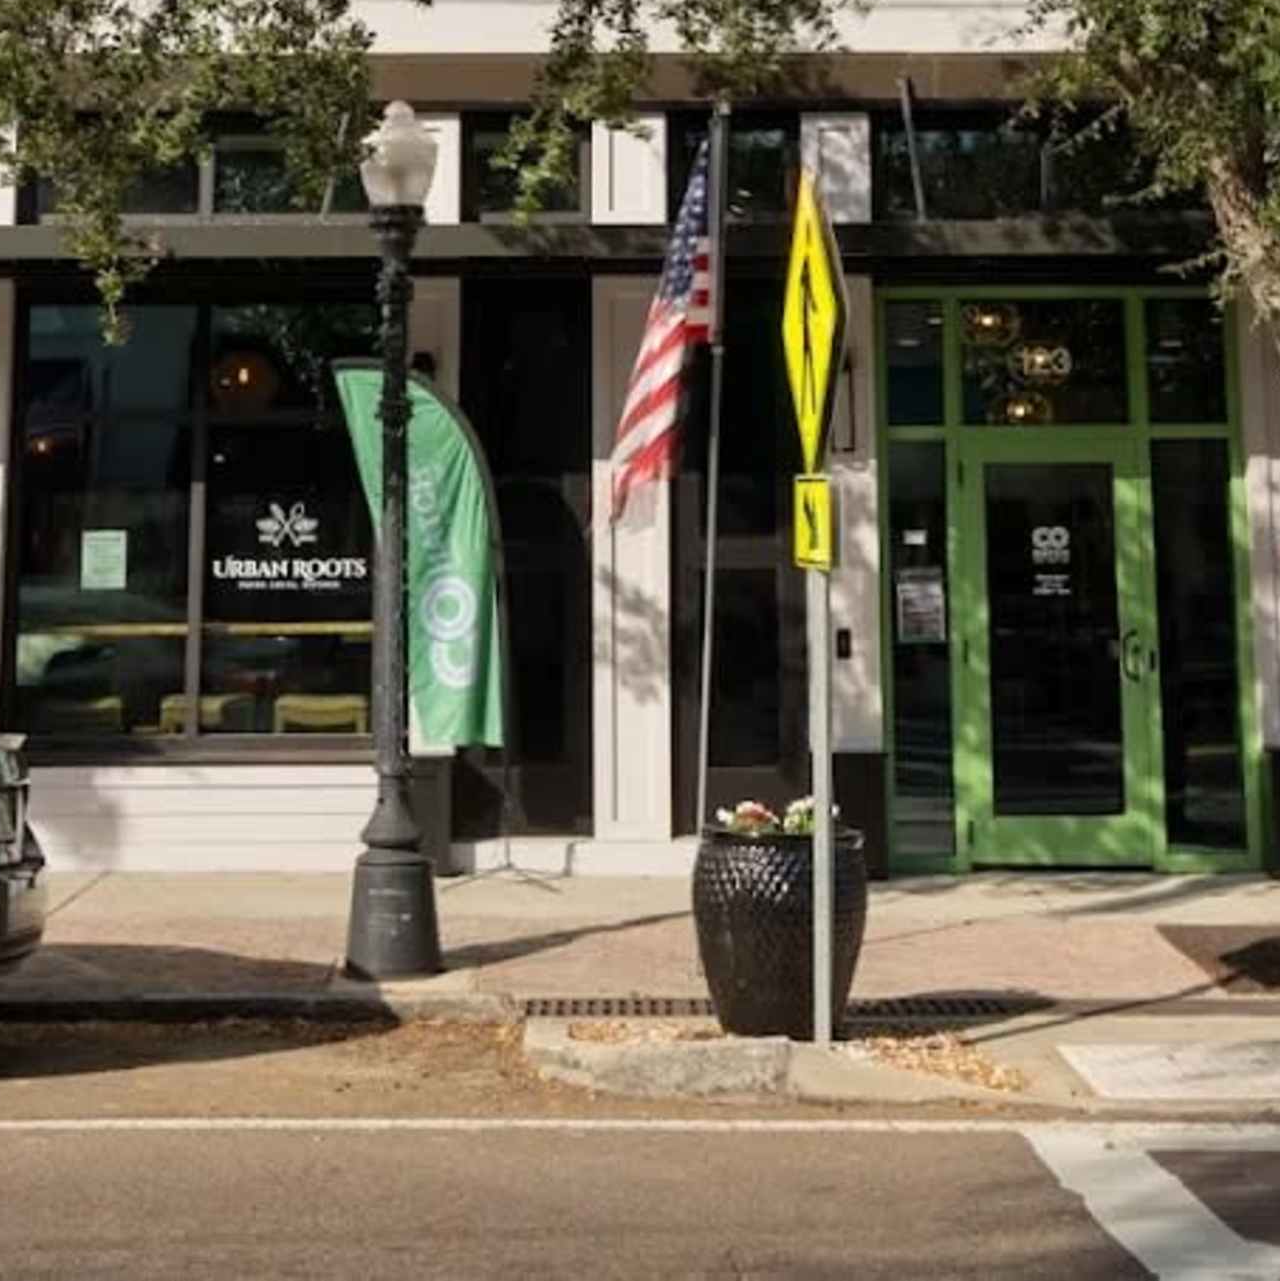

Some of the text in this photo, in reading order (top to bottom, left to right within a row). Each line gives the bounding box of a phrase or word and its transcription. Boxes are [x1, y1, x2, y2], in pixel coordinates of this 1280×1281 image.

[1021, 346, 1072, 375] 123
[212, 554, 368, 582] URBAN ROOTS
